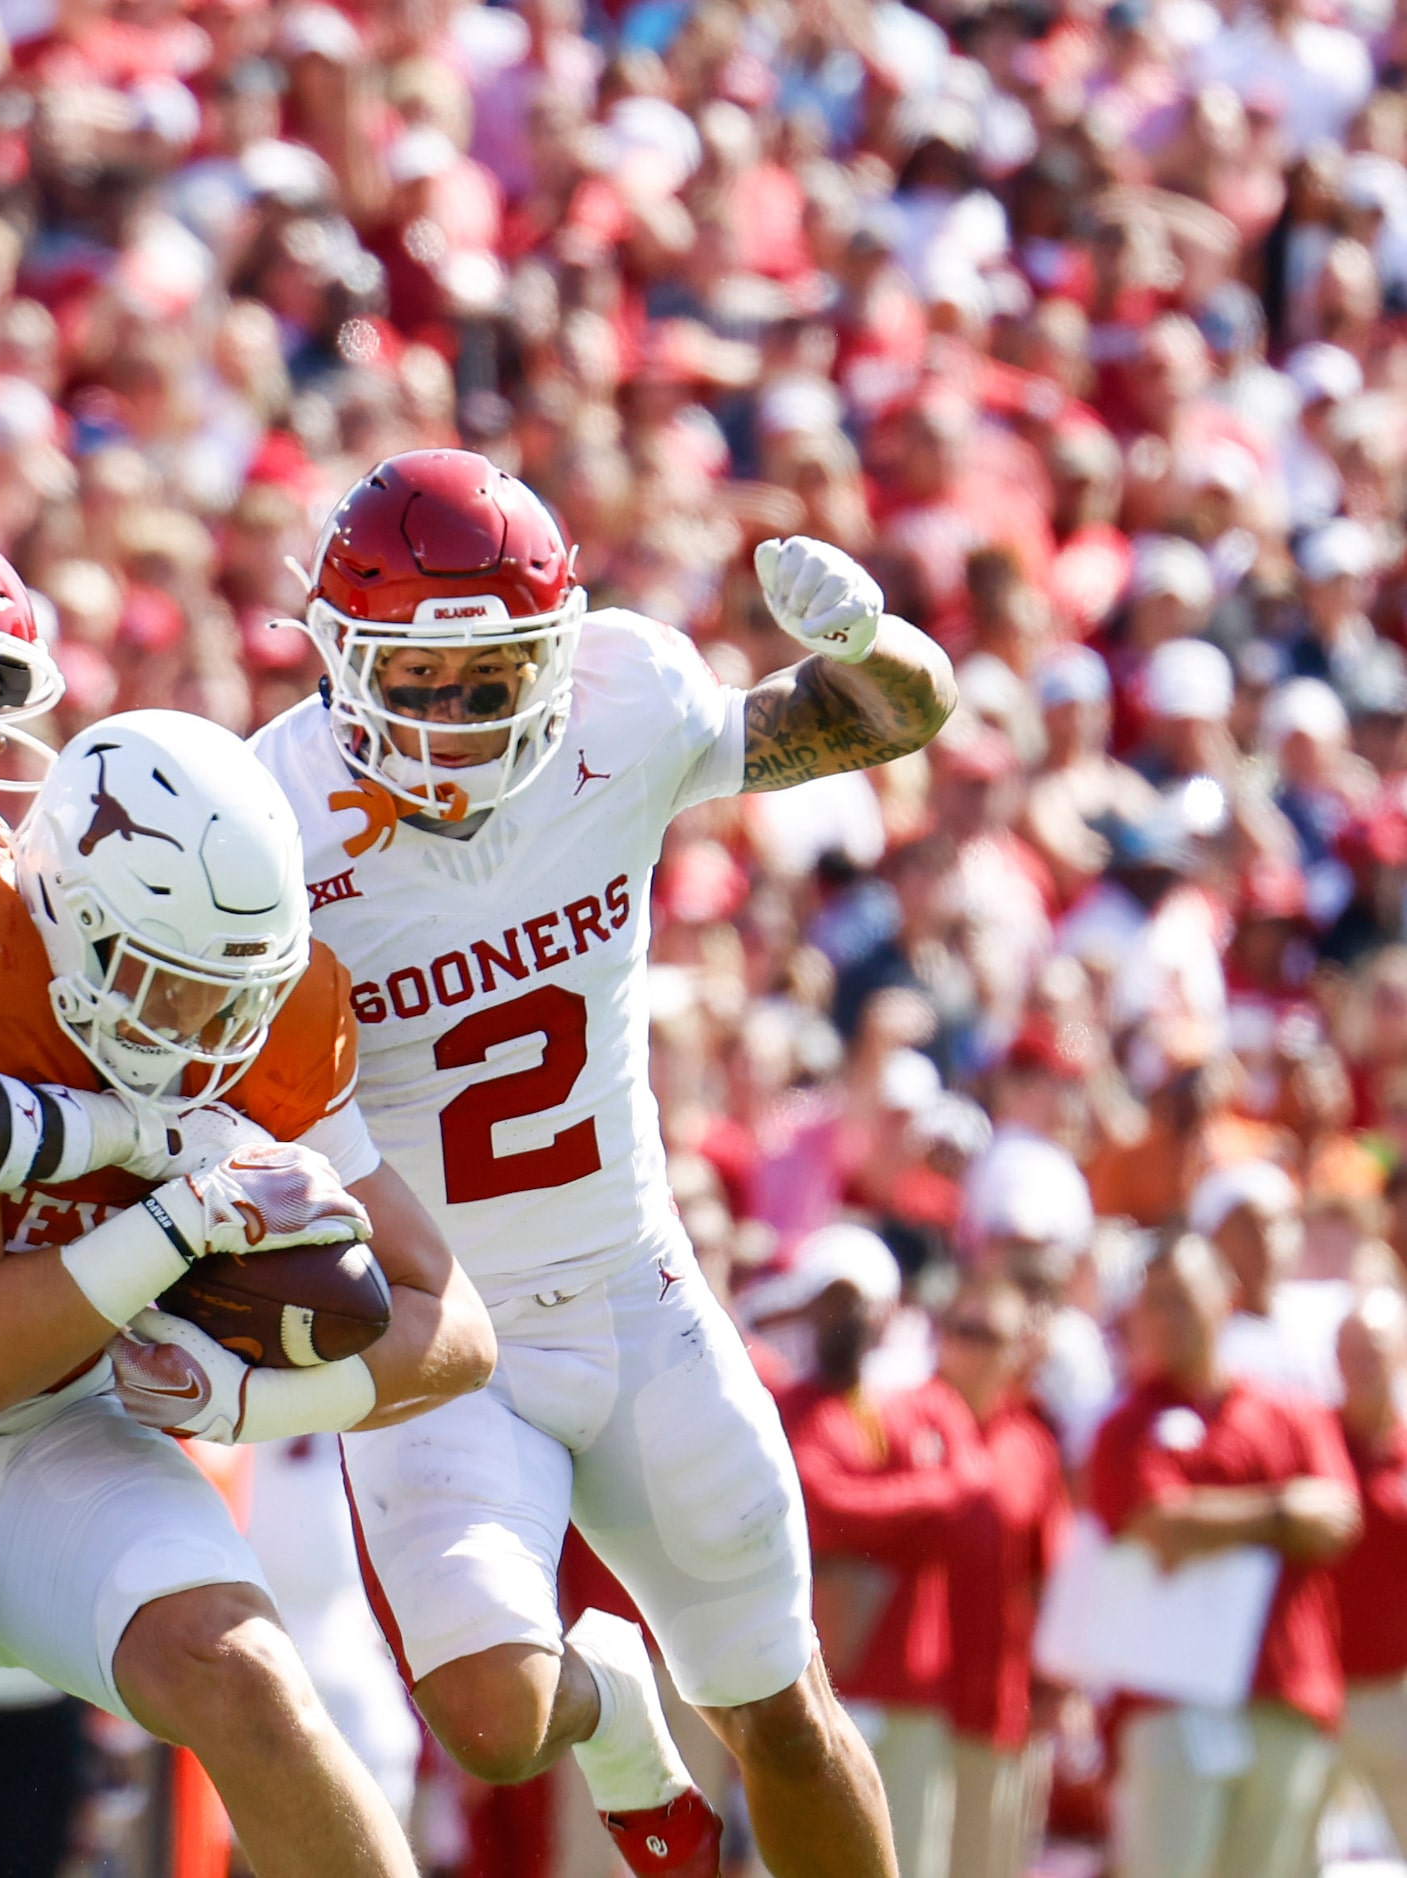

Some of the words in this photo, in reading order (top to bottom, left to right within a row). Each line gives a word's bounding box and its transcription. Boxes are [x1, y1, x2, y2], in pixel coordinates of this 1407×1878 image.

[306, 866, 364, 914] XII
[350, 873, 630, 1024] SOONERS
[433, 983, 602, 1205] 2
[145, 1198, 173, 1229] #FAFO
